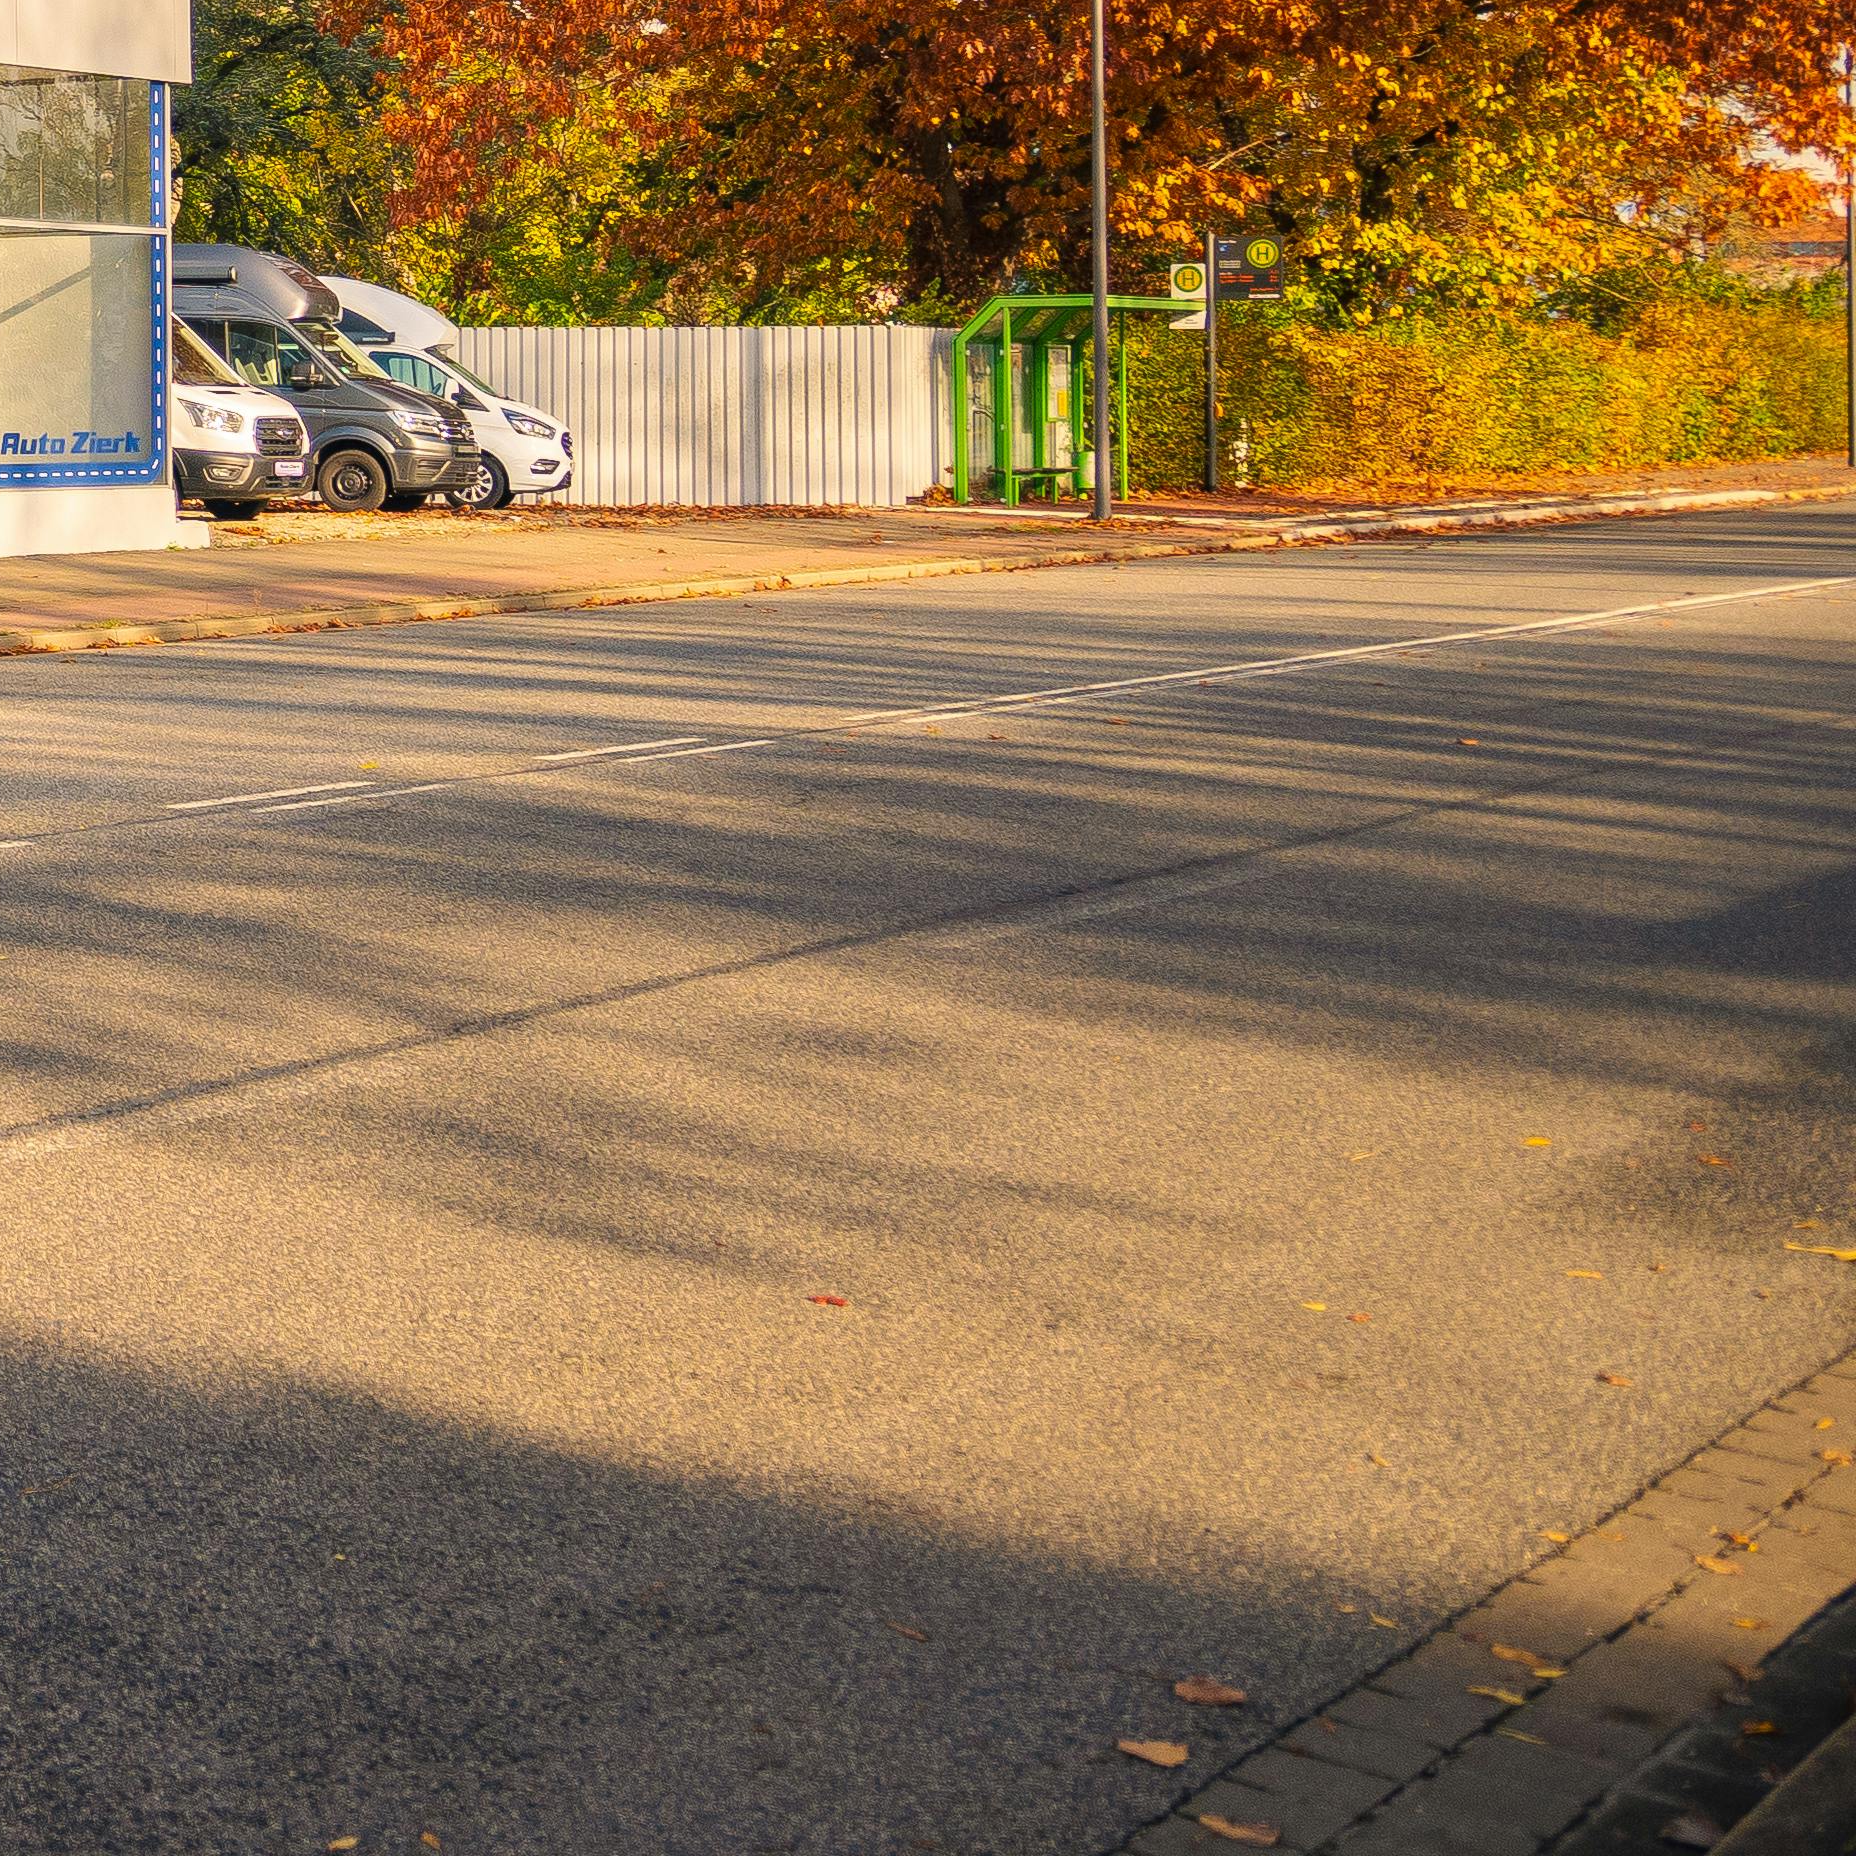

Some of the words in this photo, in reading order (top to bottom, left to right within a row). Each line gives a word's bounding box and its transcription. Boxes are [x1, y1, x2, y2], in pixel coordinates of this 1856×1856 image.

[1257, 247, 1269, 260] H
[1182, 271, 1195, 286] H
[0, 432, 66, 455] Auto
[70, 431, 141, 454] Zierk
